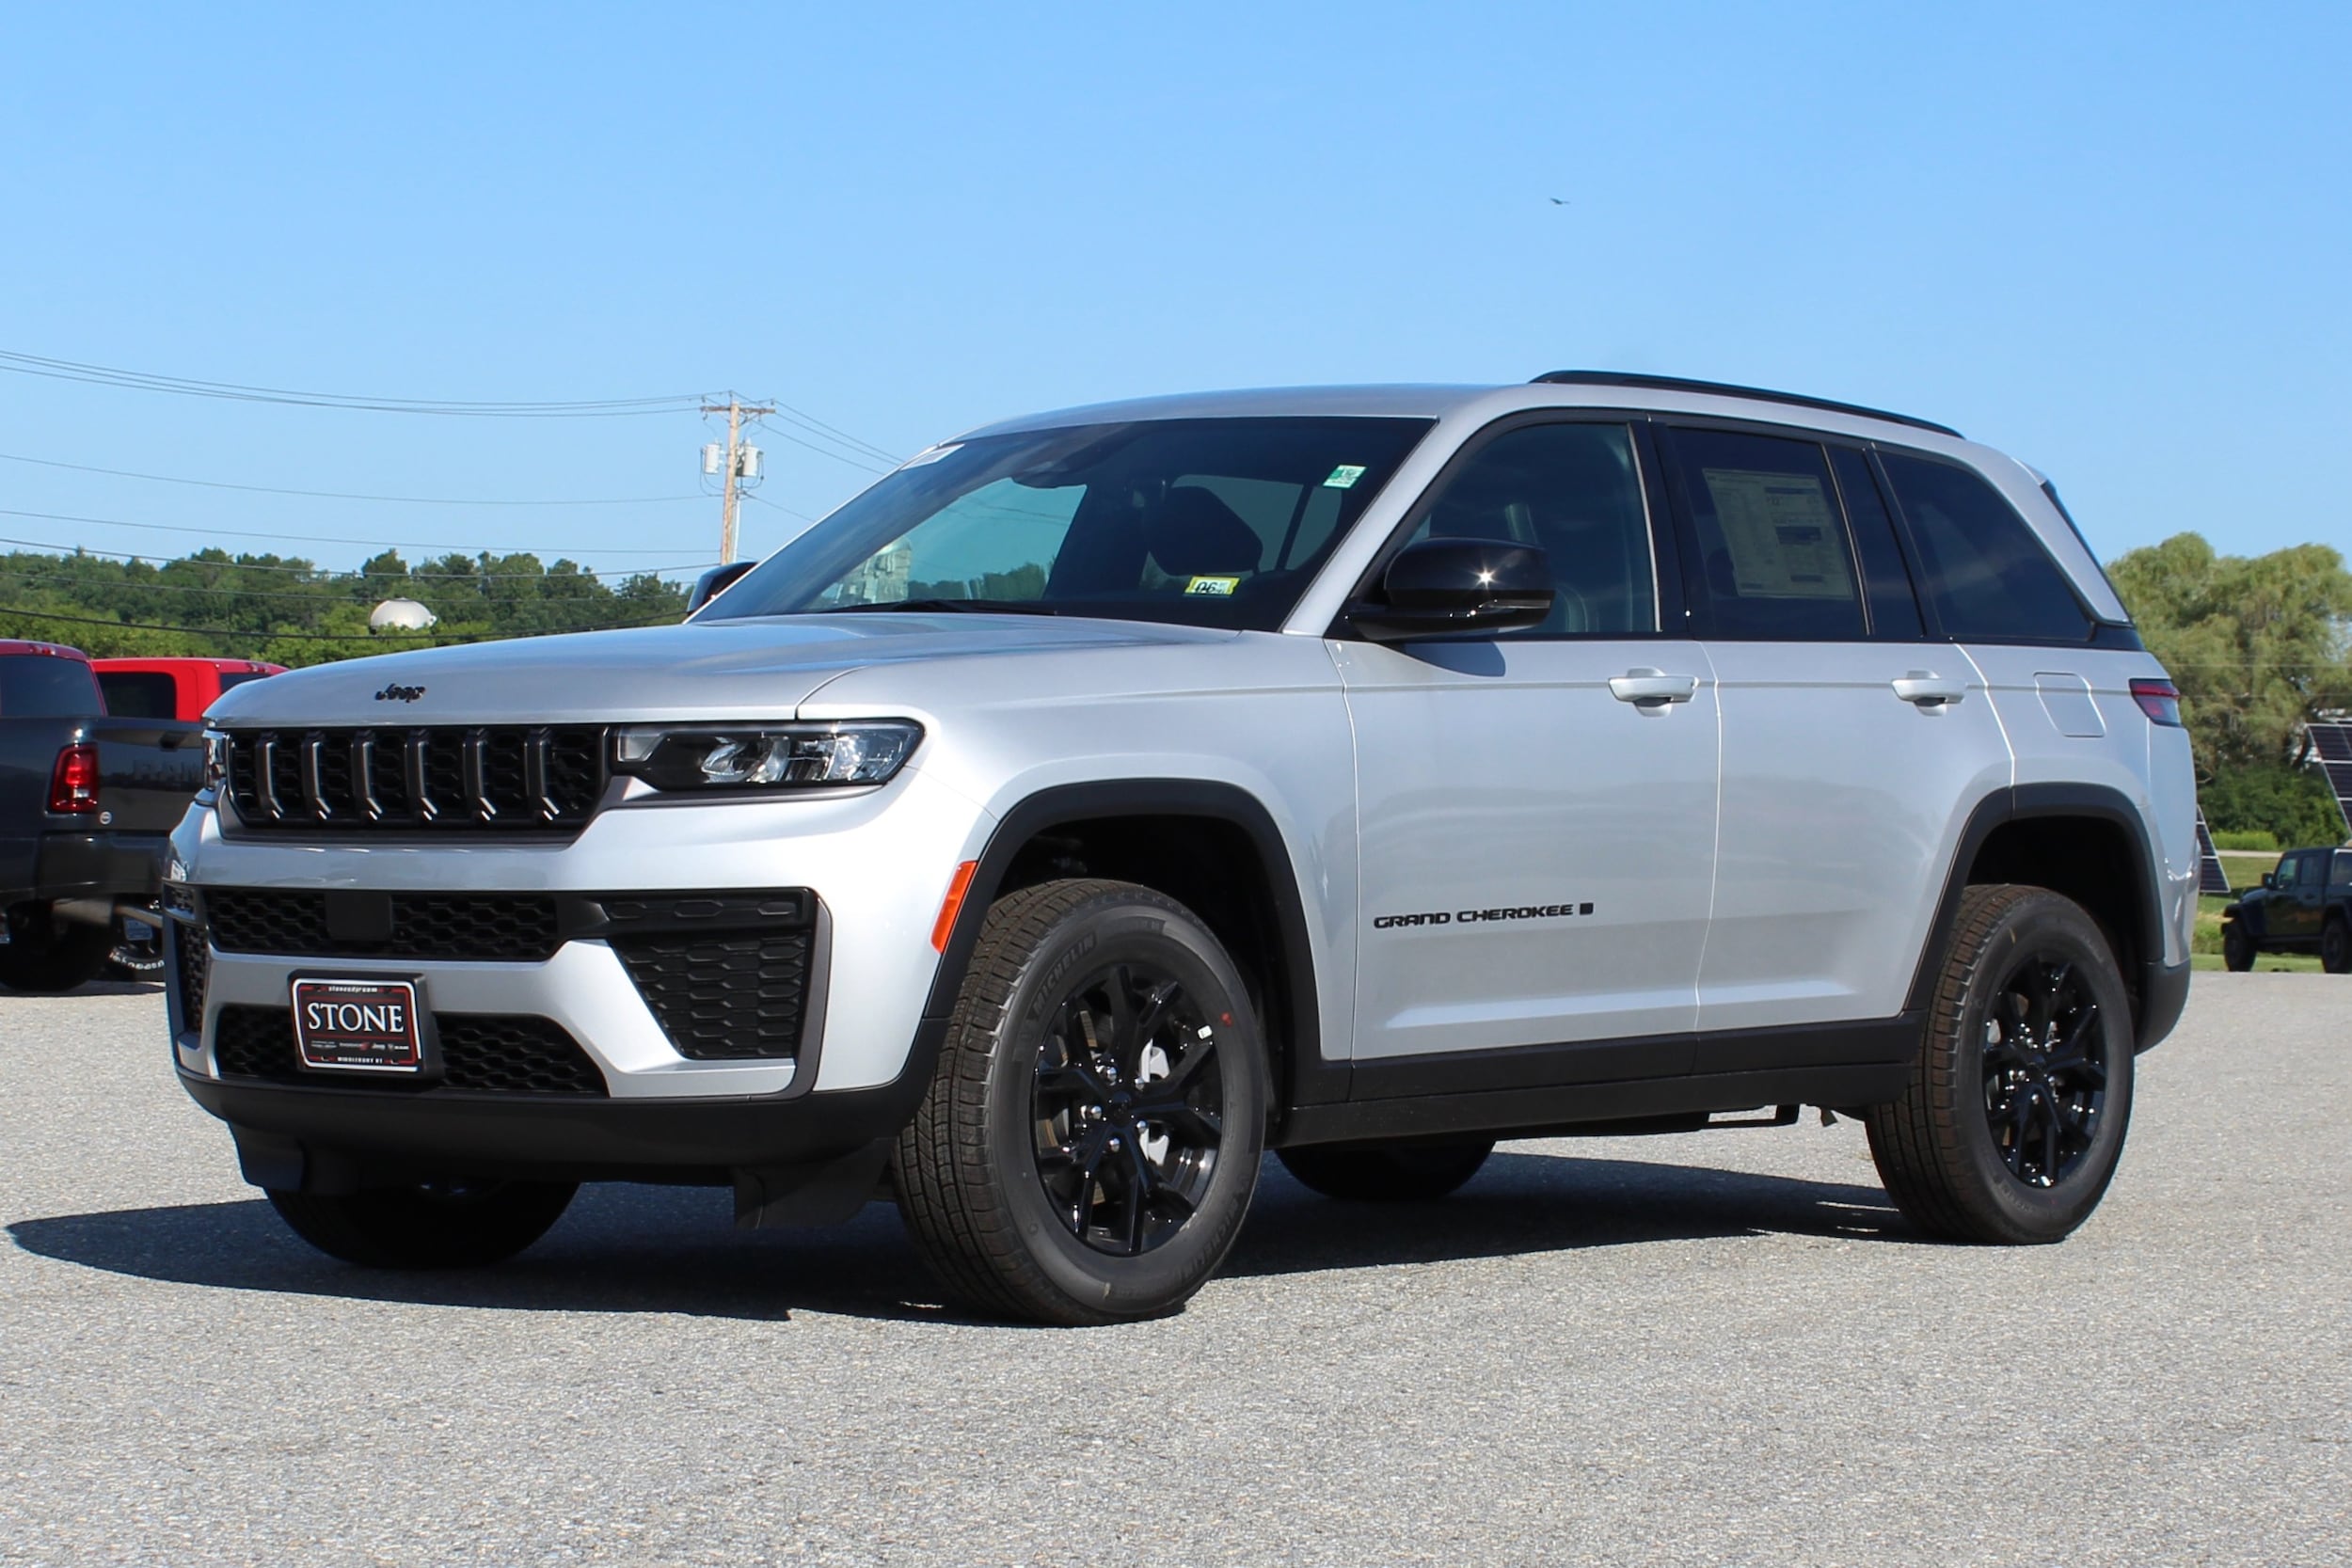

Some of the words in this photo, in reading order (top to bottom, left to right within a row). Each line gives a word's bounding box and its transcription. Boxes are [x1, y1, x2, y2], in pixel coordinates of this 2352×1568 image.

[375, 683, 425, 704] Jeep
[1374, 911, 1451, 928] GRAND
[1456, 904, 1574, 923] CHEROKEE
[1033, 932, 1095, 1016] MICHELIN
[307, 1002, 405, 1033] STONE
